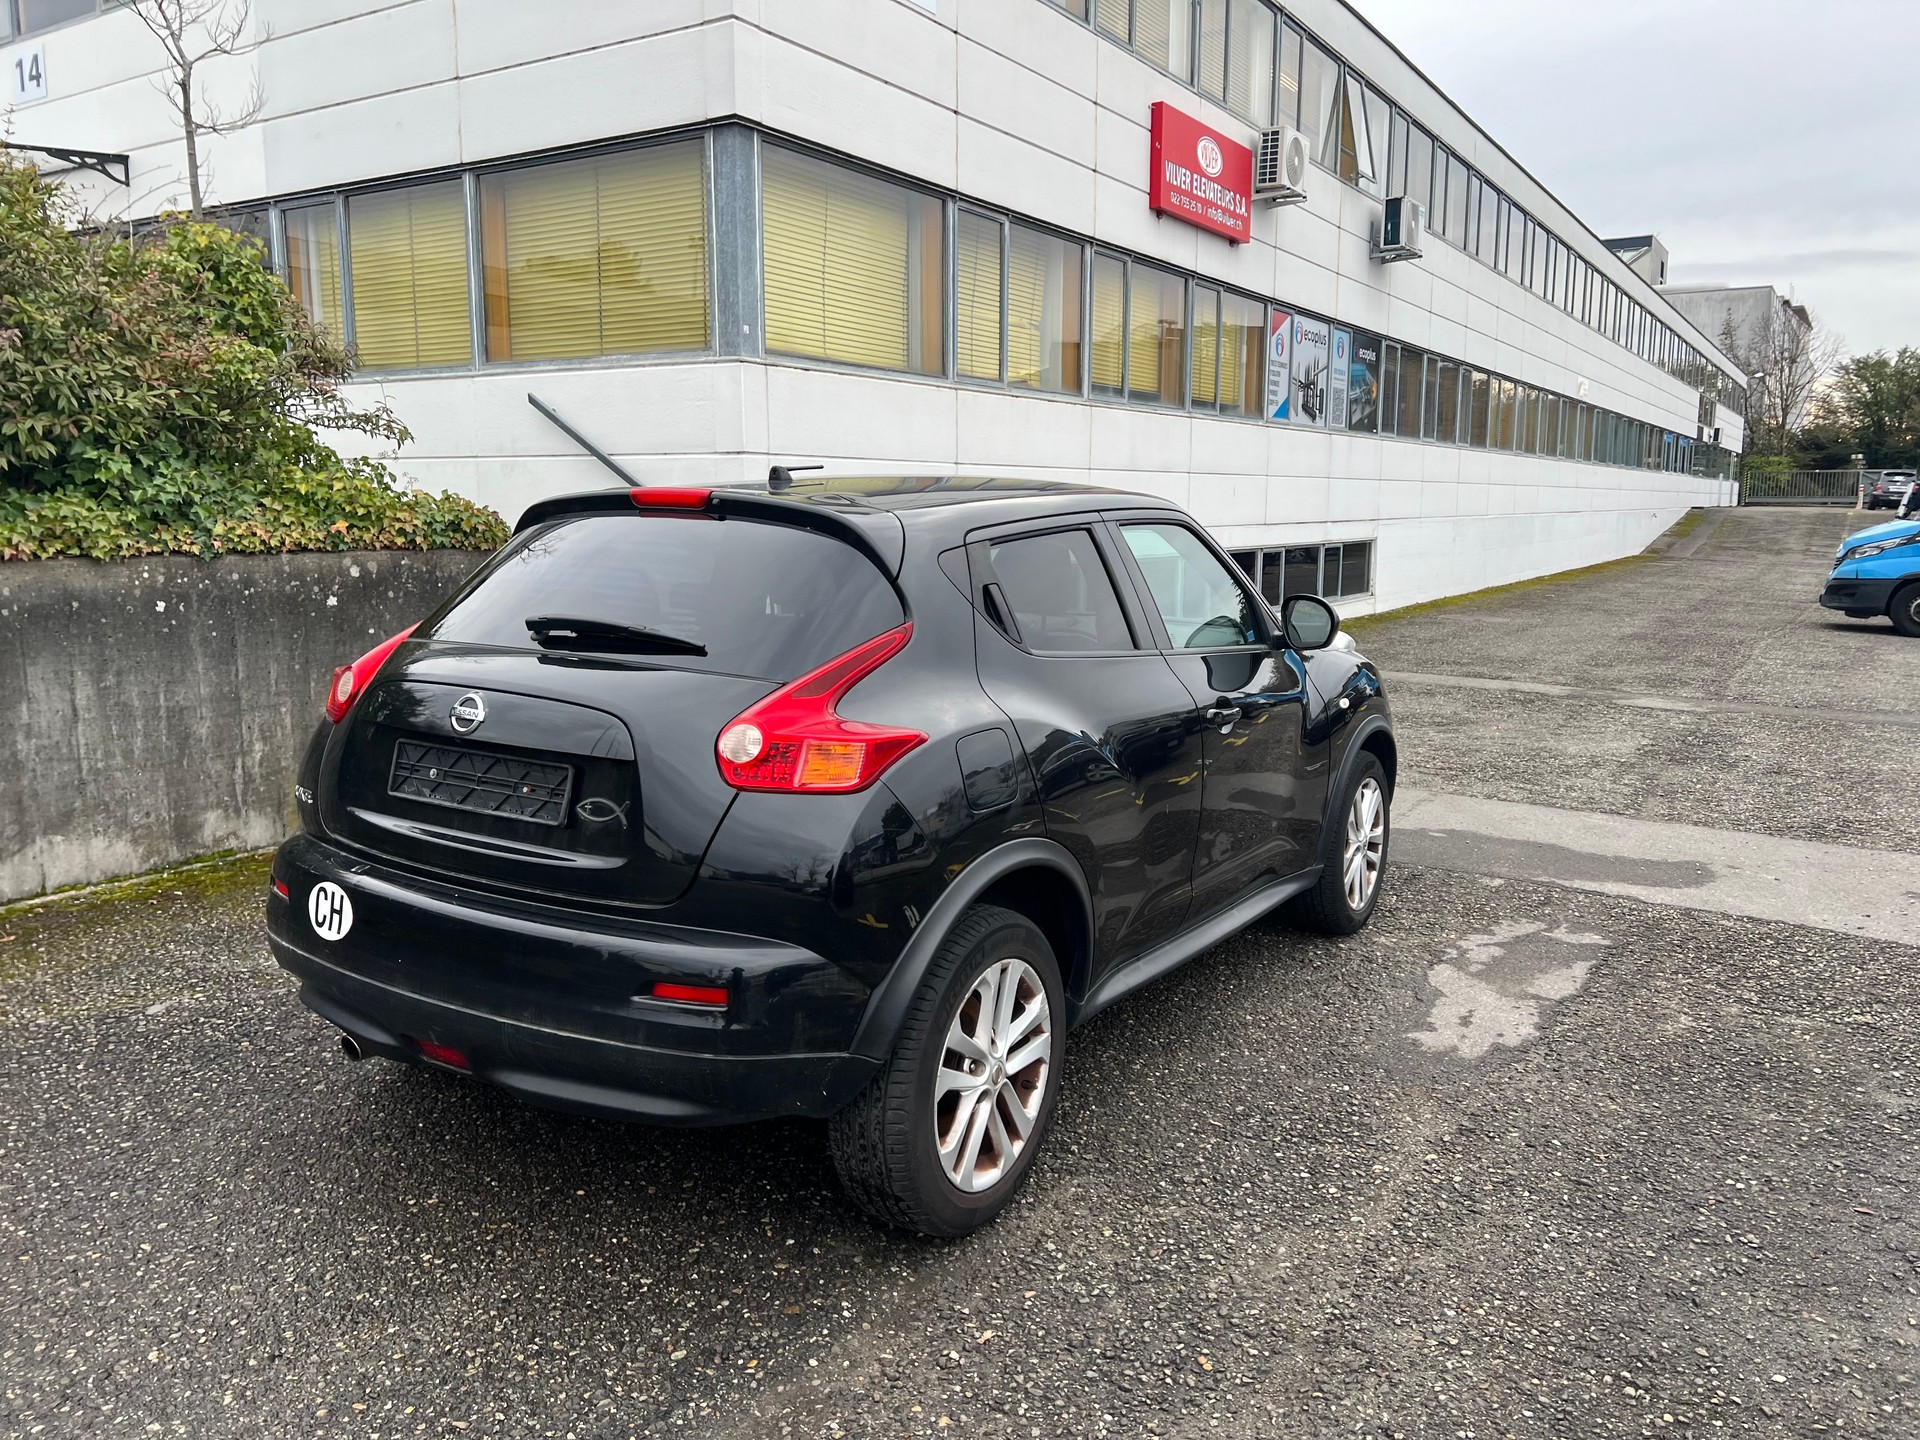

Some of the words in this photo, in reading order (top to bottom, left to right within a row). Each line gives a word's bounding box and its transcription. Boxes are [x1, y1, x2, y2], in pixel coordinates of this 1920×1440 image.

[15, 53, 42, 92] 14
[1165, 160, 1191, 192] VILVER
[1193, 174, 1234, 211] ELEVATEURS
[1235, 194, 1248, 217] S.A.
[1171, 192, 1180, 204] 022
[1207, 203, 1243, 230] info@vilver.ch
[1304, 327, 1327, 349] ecoplus
[1359, 347, 1377, 362] ecoplus
[315, 886, 344, 935] CH
